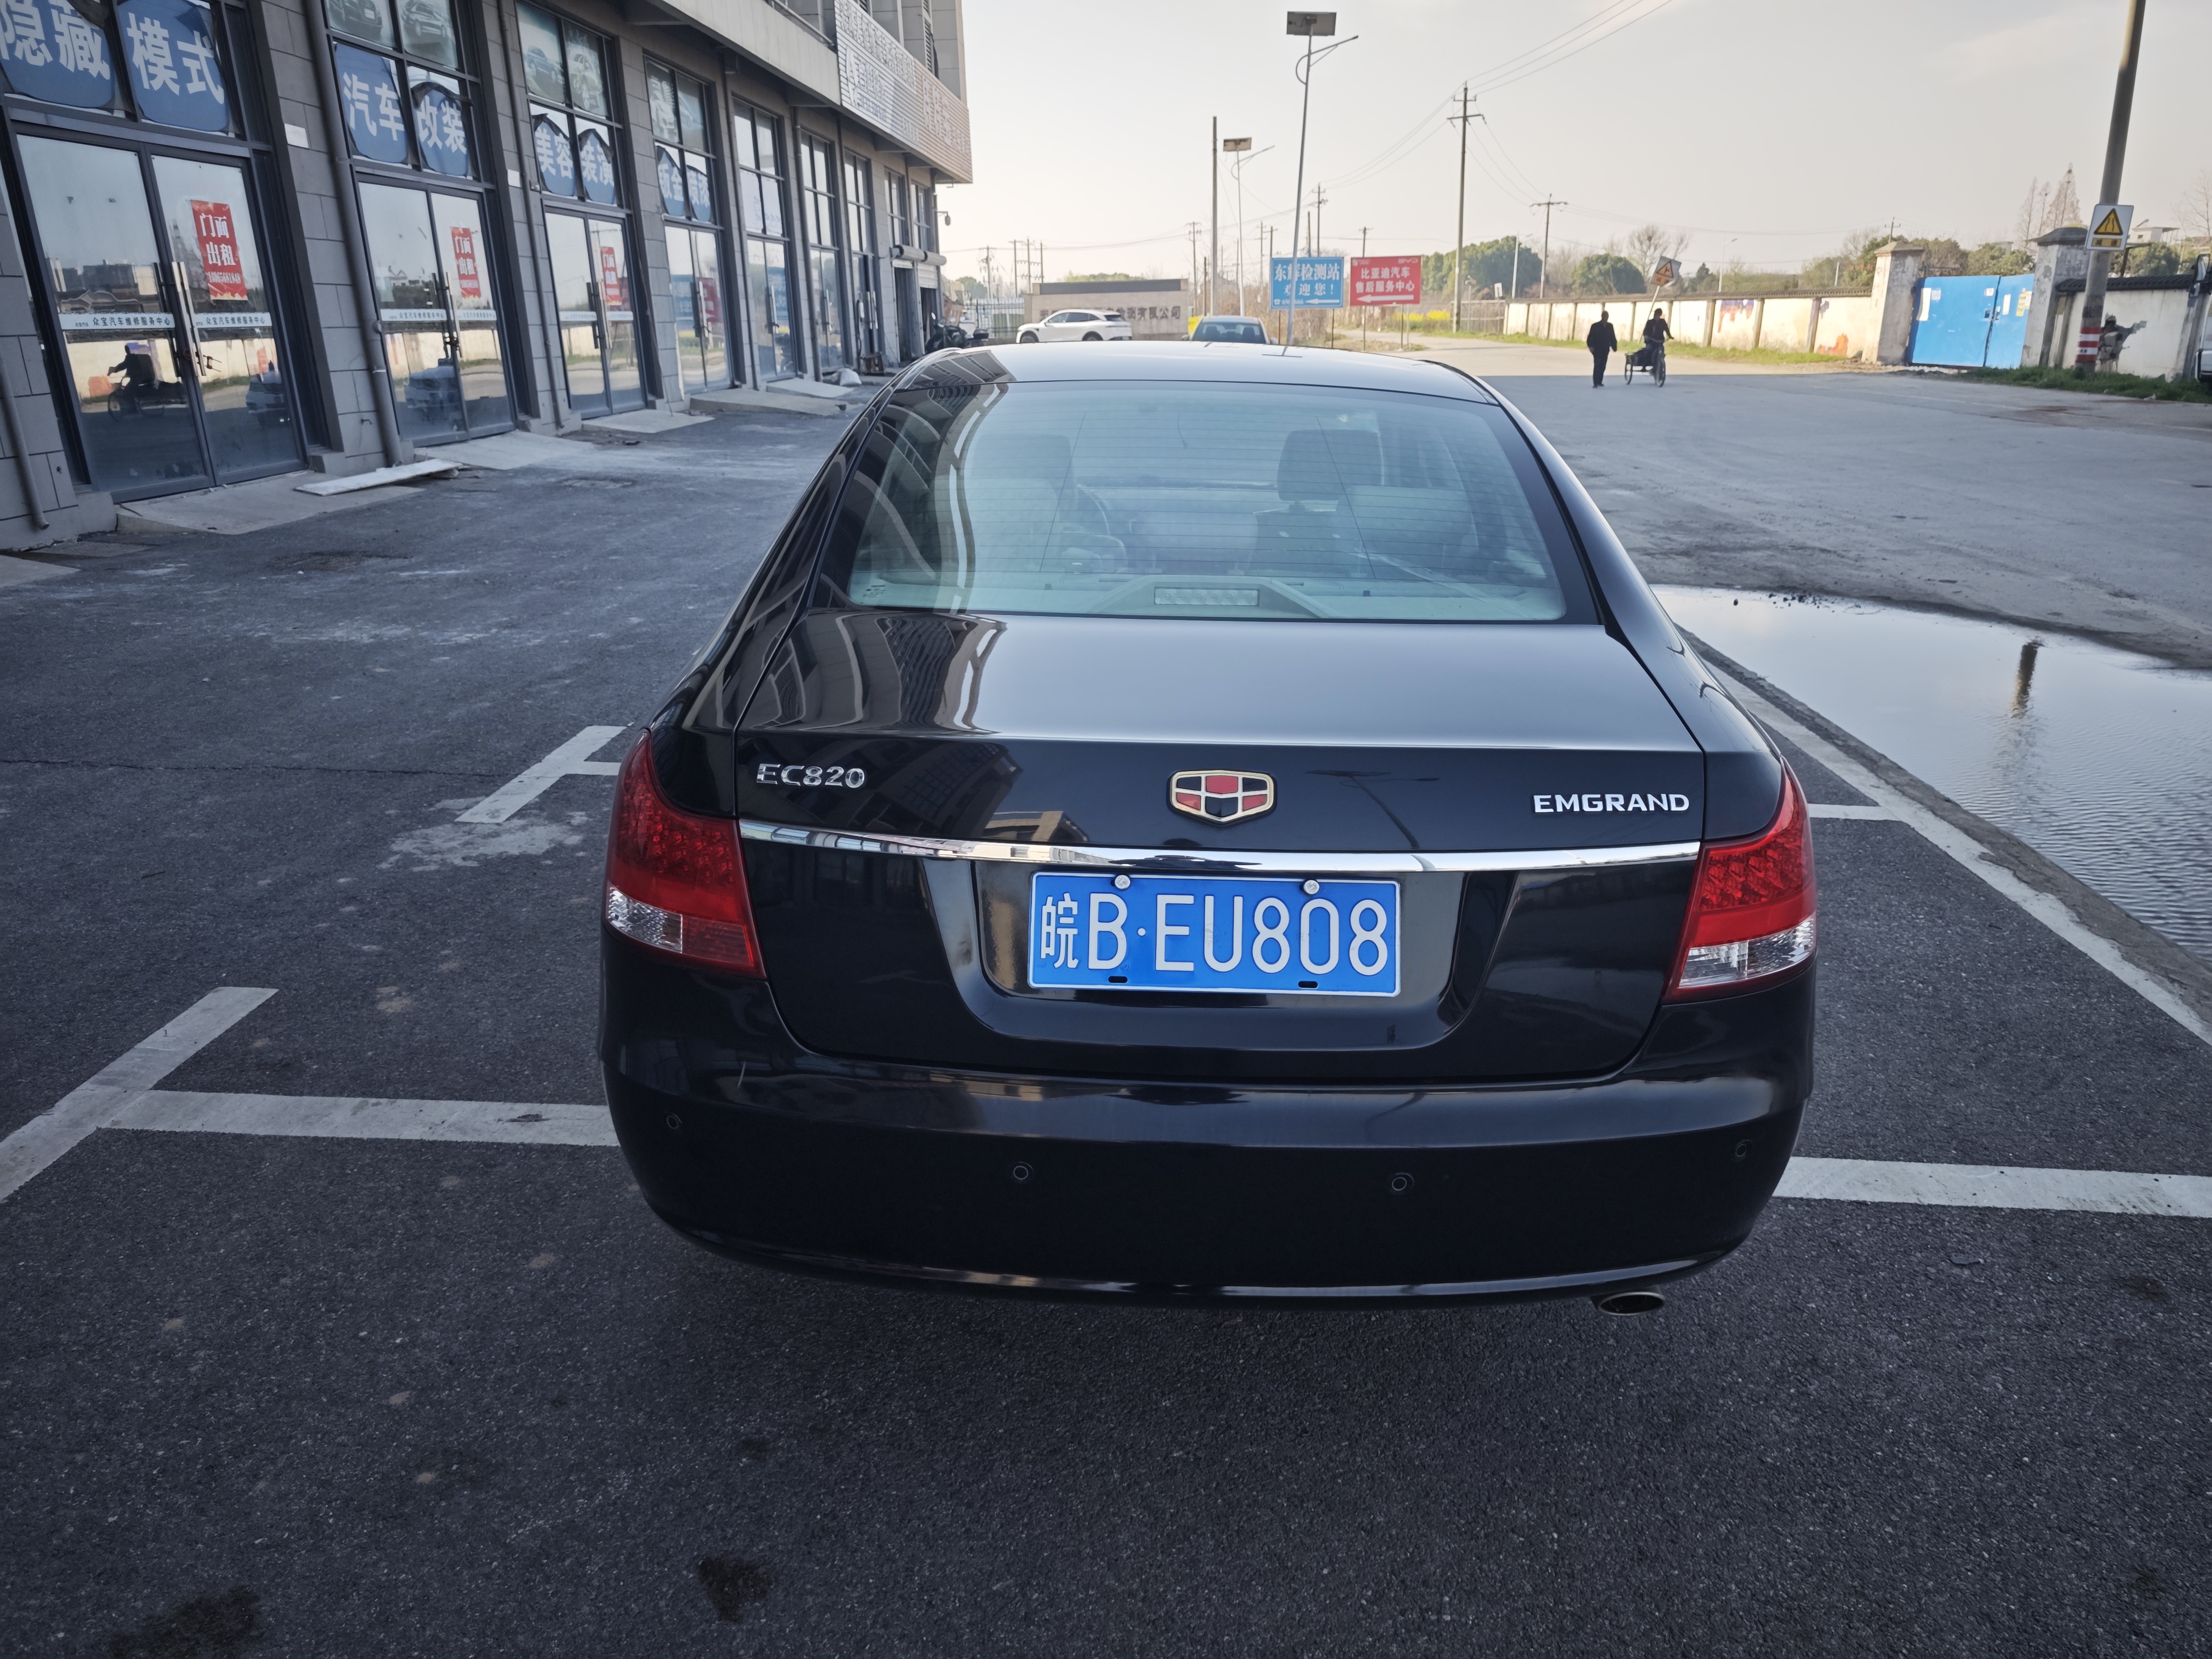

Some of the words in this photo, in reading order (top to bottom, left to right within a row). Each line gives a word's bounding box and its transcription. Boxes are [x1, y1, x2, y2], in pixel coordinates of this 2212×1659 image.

[0, 0, 110, 80] 隐藏
[126, 12, 225, 105] 模式
[343, 72, 404, 141] 汽车
[416, 95, 467, 155] 改装
[535, 127, 574, 179] 美容
[199, 212, 230, 239] 门面
[206, 241, 236, 266] 出租
[1361, 266, 1411, 279] 比亚迪汽车
[92, 316, 171, 326] 众宝汽车维修服务中心
[756, 763, 865, 788] EC820
[1533, 793, 1690, 813] EMGRAND
